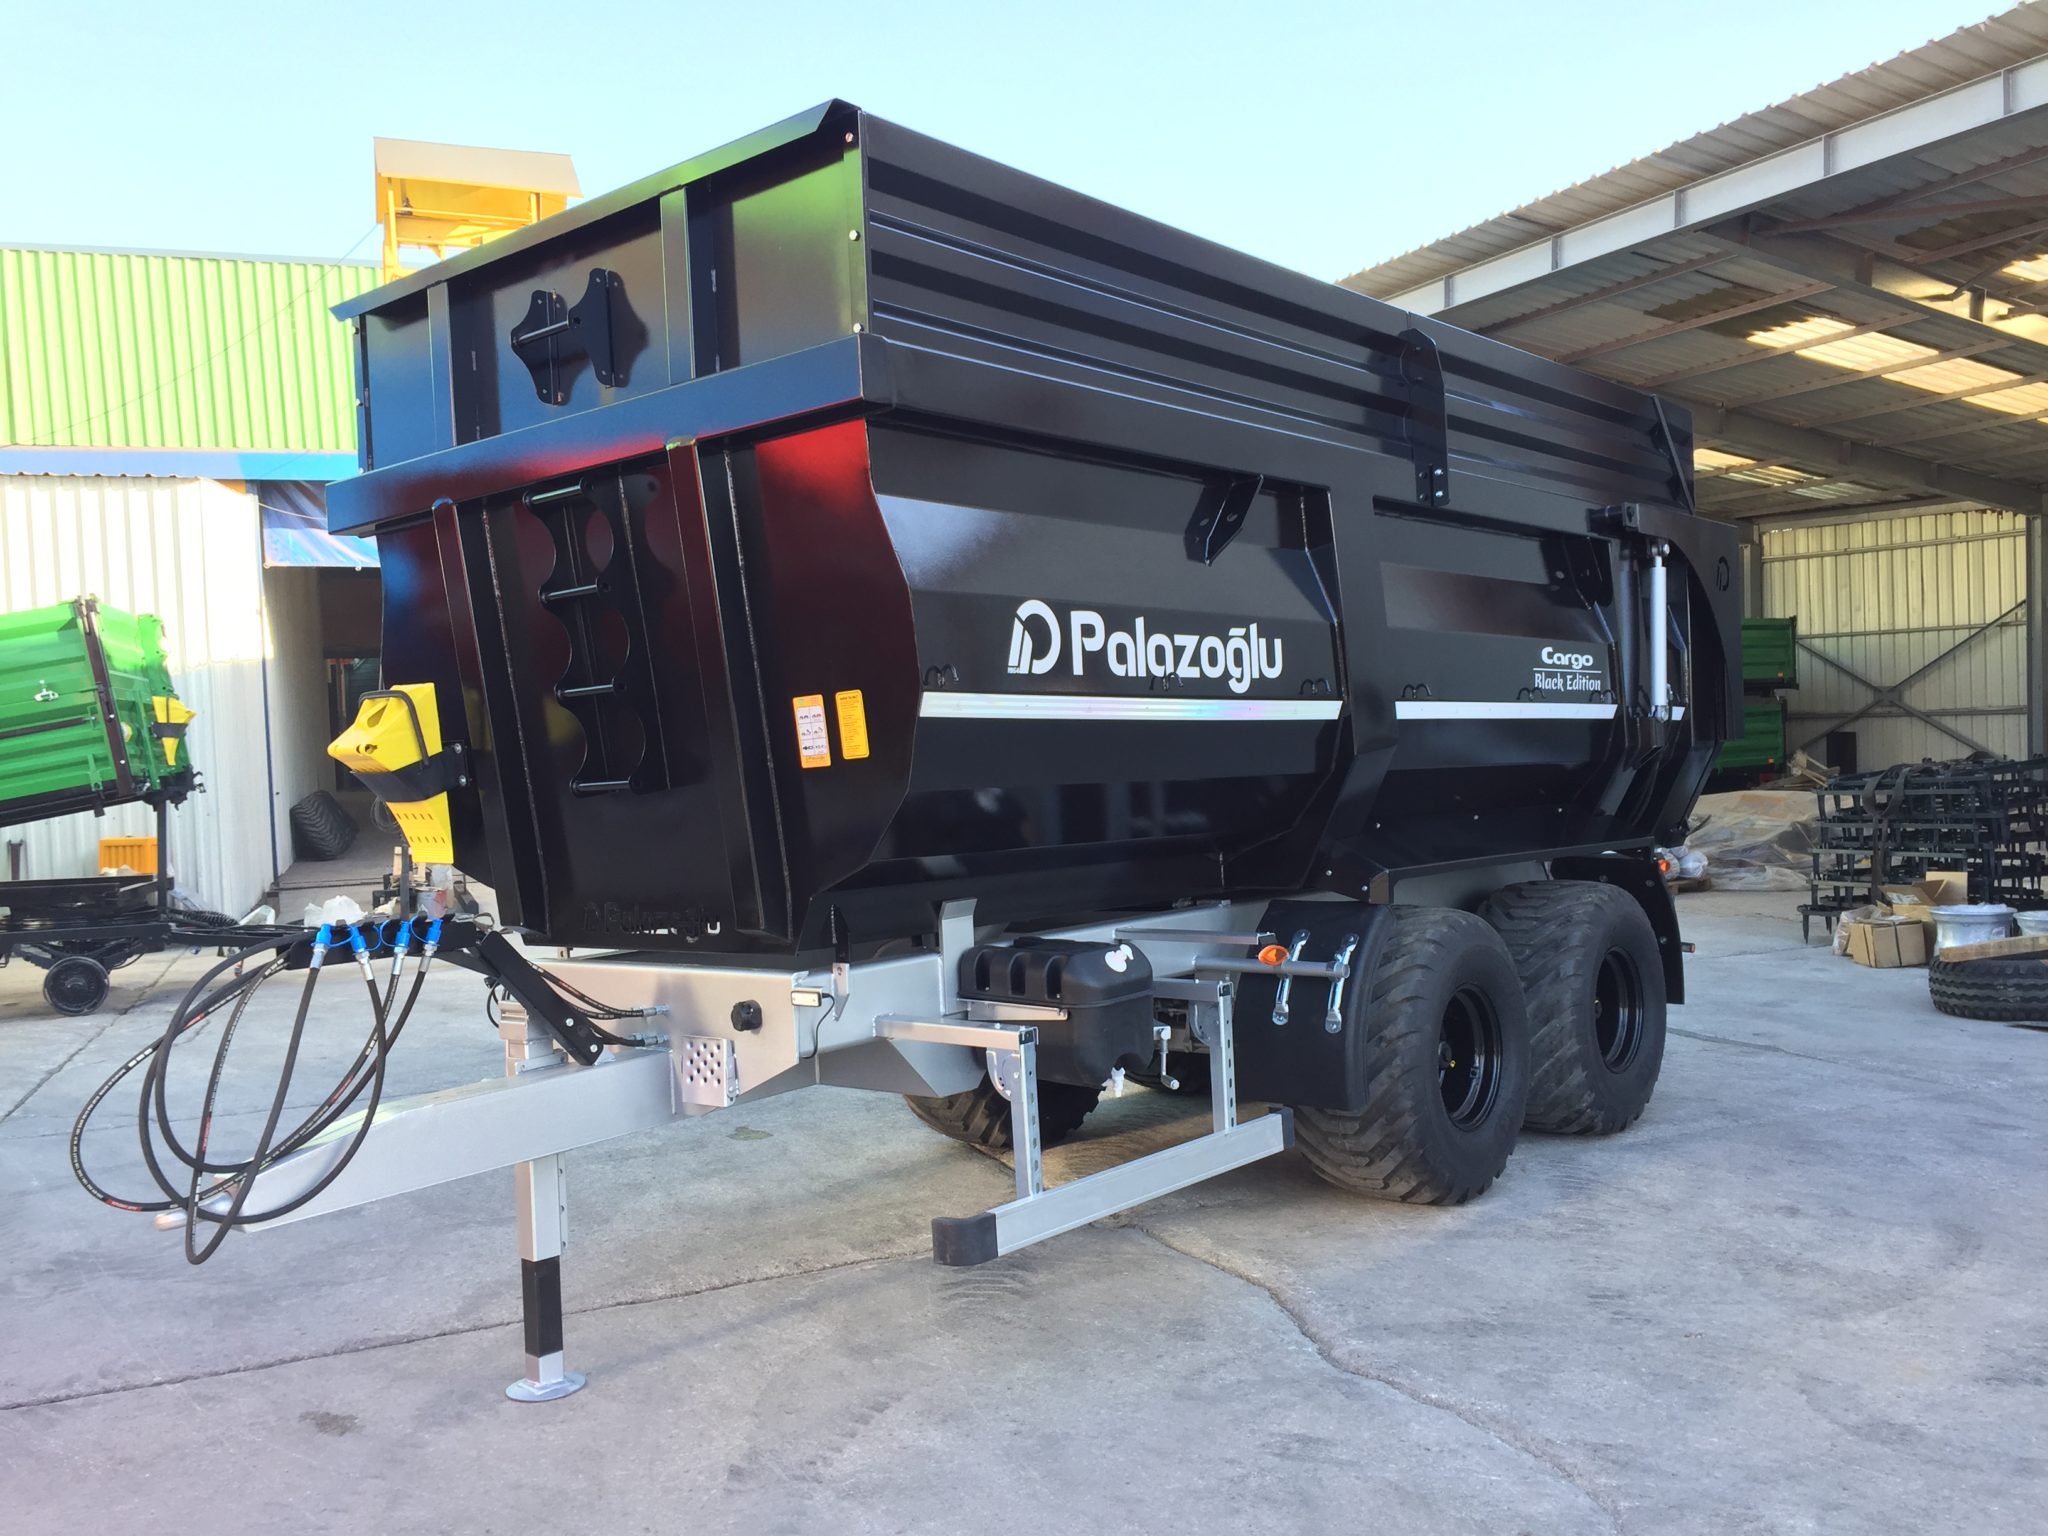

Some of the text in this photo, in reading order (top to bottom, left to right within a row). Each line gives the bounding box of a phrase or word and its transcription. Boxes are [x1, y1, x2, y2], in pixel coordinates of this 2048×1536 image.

[1540, 645, 1594, 670] Cargo
[1534, 671, 1602, 692] Black Edition
